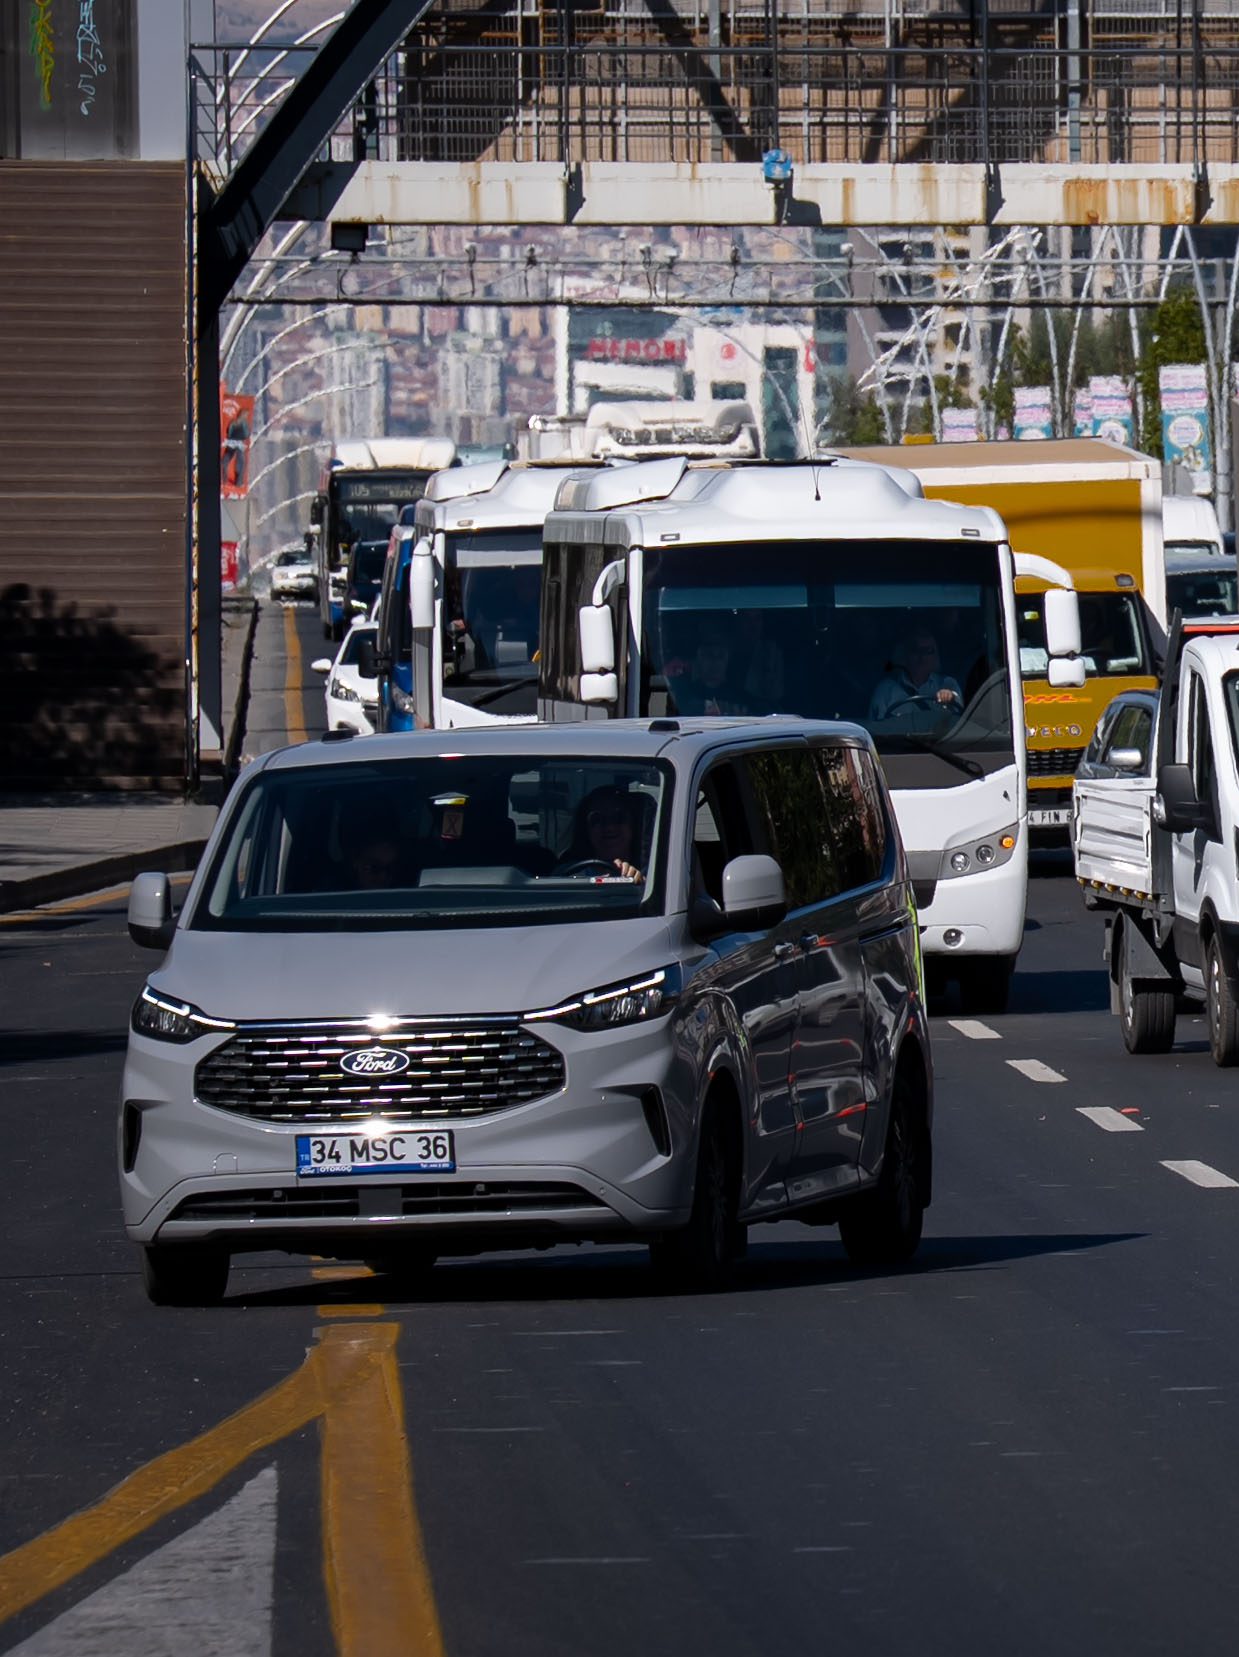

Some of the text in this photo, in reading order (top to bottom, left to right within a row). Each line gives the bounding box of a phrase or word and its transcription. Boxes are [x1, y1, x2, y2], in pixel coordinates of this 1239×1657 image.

[352, 1052, 398, 1072] Ford
[311, 1139, 342, 1164] 34
[350, 1136, 406, 1162] MSC
[416, 1135, 448, 1160] 36
